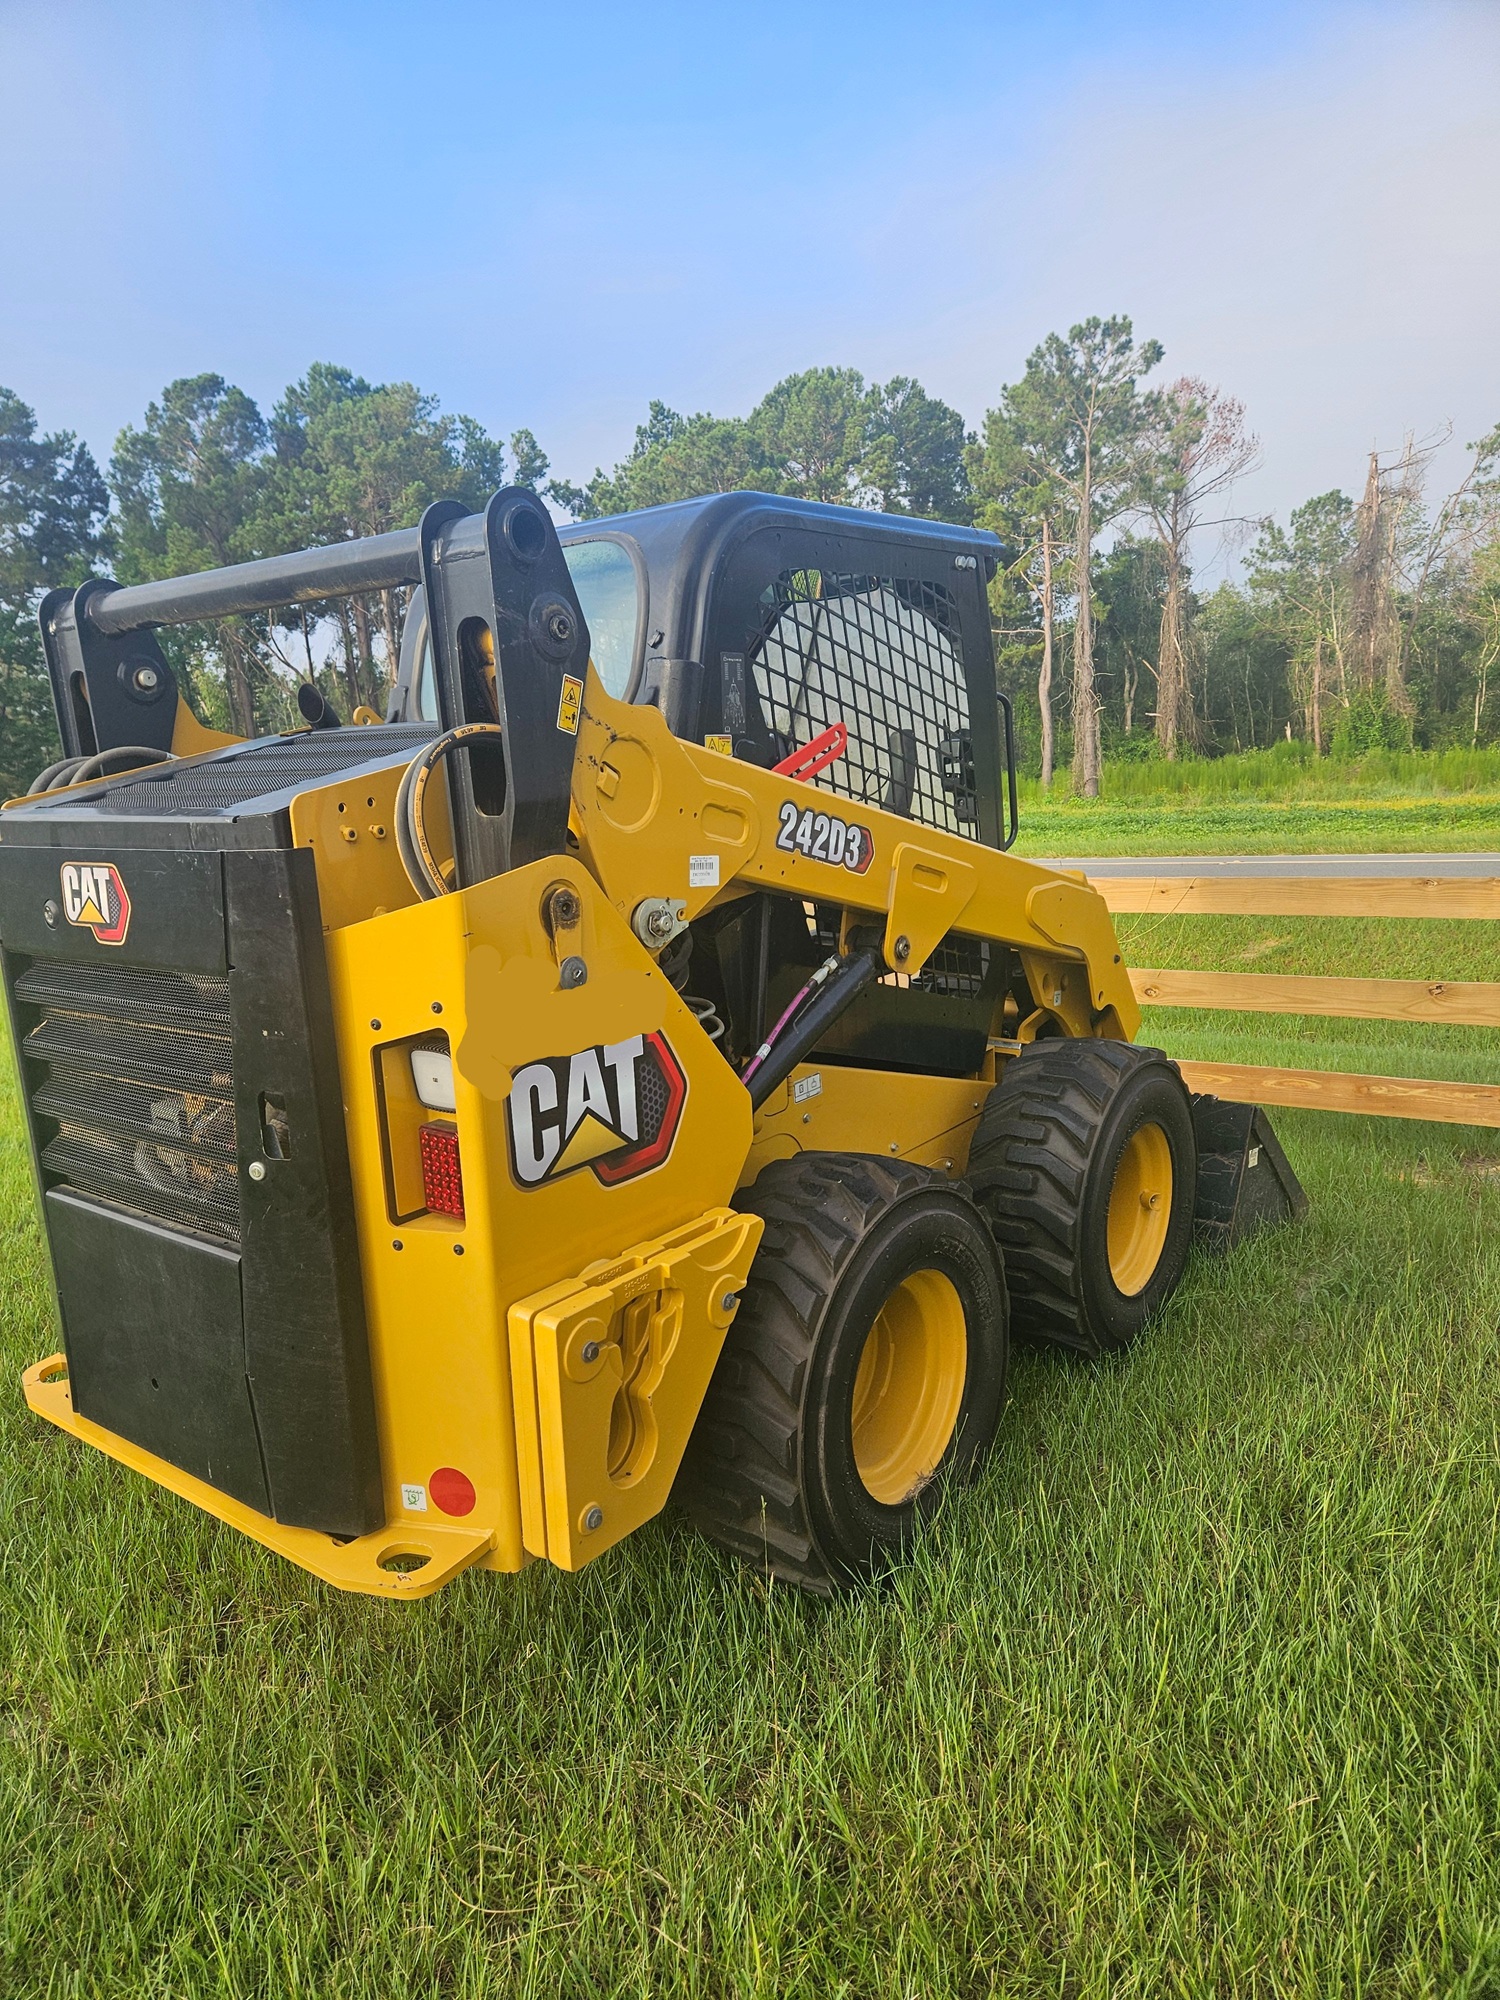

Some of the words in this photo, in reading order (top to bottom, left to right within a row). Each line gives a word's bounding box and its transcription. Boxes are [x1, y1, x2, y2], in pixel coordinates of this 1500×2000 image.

[778, 803, 861, 868] 242D3
[63, 865, 111, 924] CAT
[510, 1034, 644, 1182] CAT
